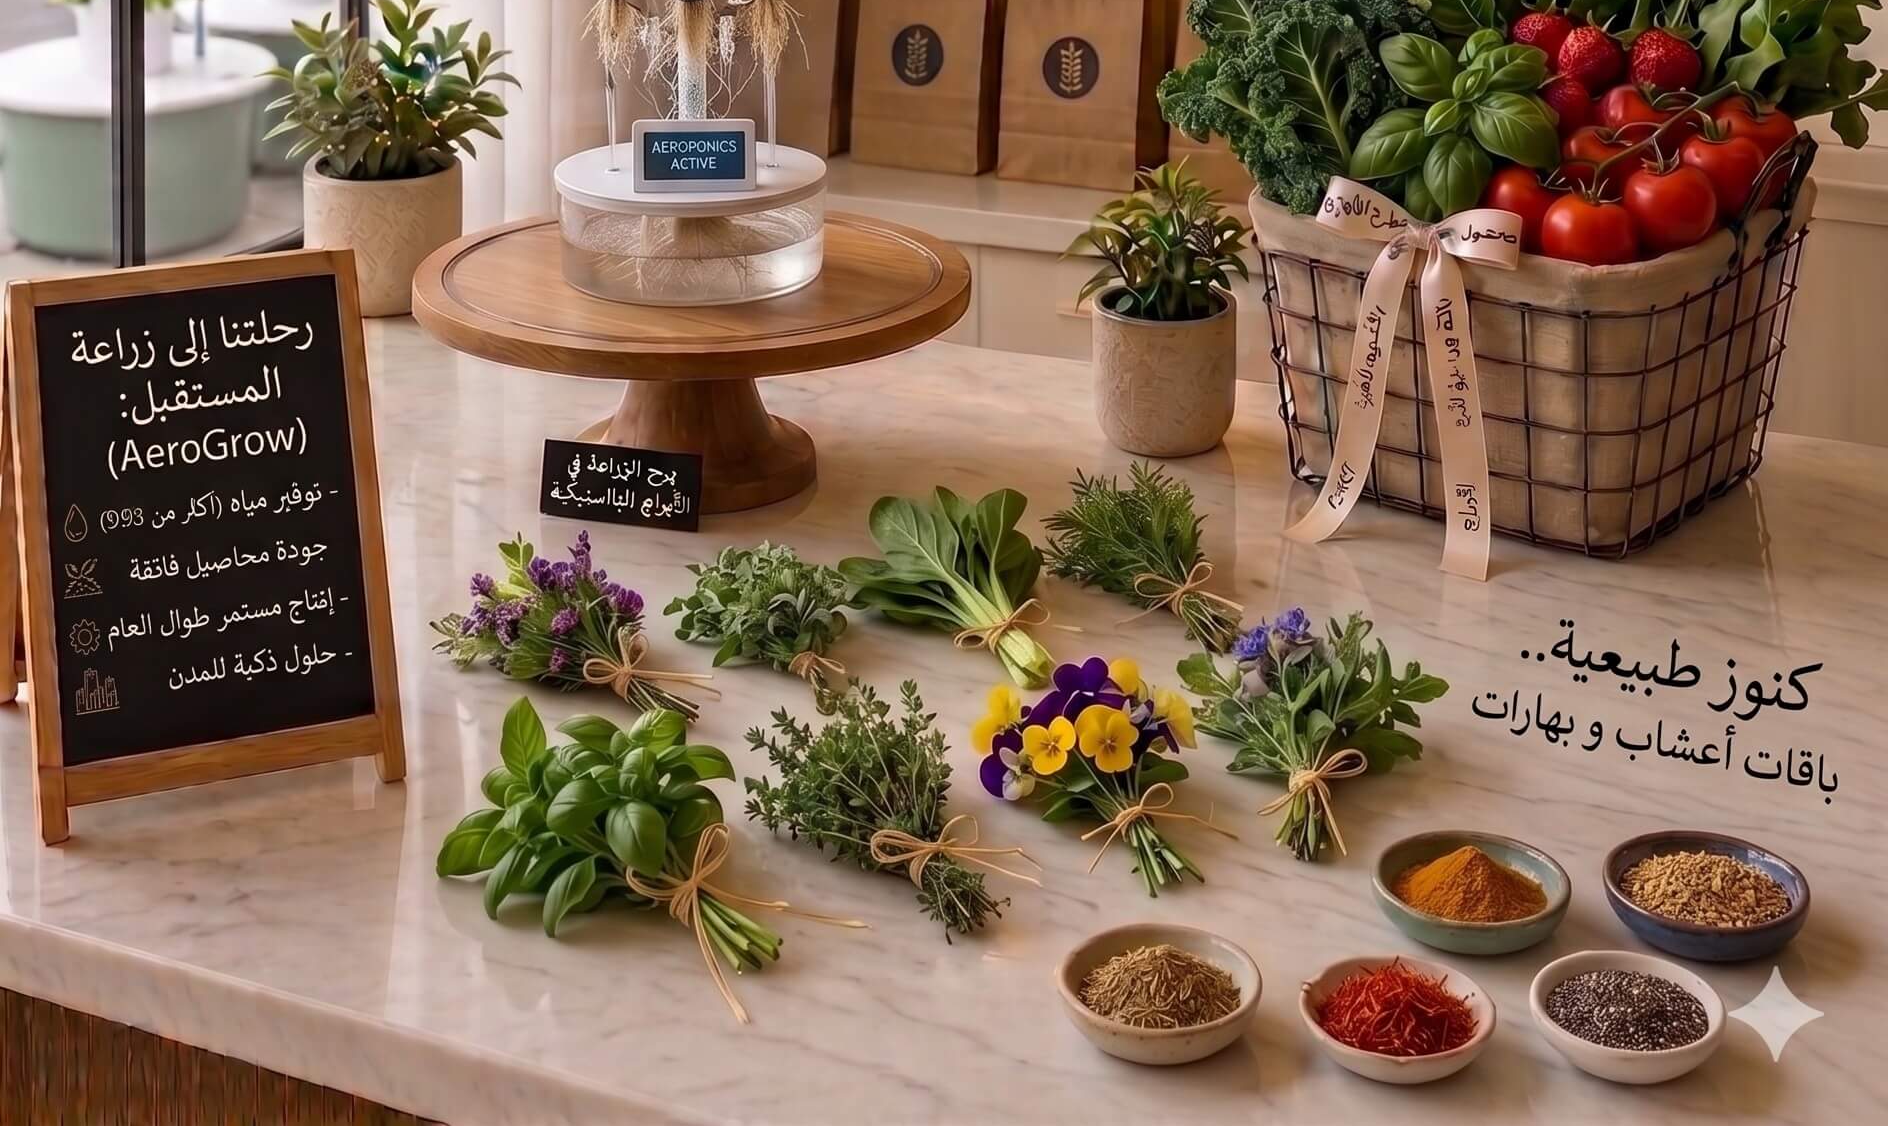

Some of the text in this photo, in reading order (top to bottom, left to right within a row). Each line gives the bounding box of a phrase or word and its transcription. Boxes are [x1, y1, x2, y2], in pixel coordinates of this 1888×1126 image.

[651, 139, 737, 154] AEROPONICS
[670, 156, 717, 170] ACTIVE
[71, 309, 314, 371] رحلتنا إلى زراعة
[119, 364, 282, 426] المستقبل:
[107, 416, 308, 481] (AeroGrow)
[151, 508, 176, 529] من
[230, 489, 268, 518] مياه
[185, 546, 270, 580] محاصيل
[276, 539, 328, 567] جودة
[107, 612, 152, 653] العام
[160, 606, 210, 639] طوال
[216, 602, 282, 632] مستمر
[168, 655, 226, 690] للمدن
[284, 642, 337, 675] حلول
[1519, 618, 1825, 722] كنوز طبيعية..
[1470, 689, 1839, 806] باقات أعشاب و بهارات
